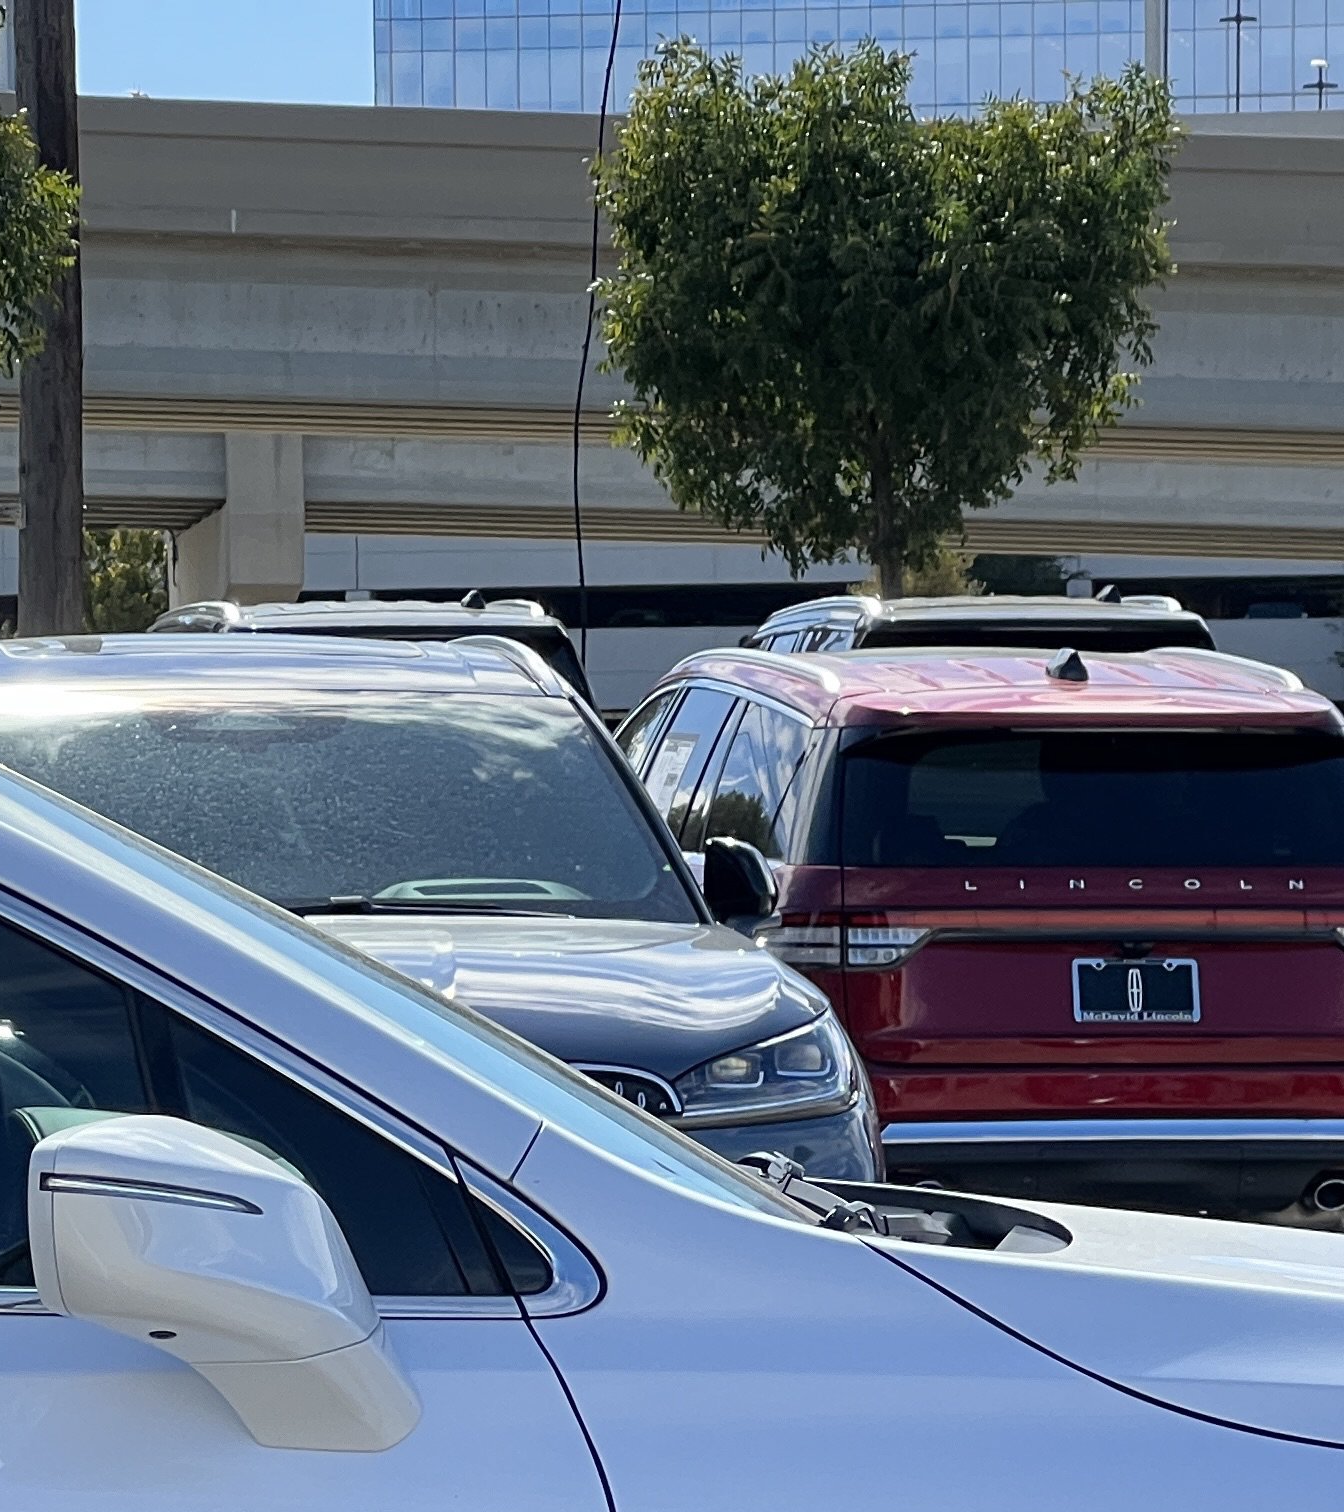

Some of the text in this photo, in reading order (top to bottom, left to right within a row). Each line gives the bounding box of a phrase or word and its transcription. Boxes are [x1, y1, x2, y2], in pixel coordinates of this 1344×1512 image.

[964, 878, 1304, 891] LINCOLN
[1083, 1011, 1192, 1021] McDavid Lincoln
